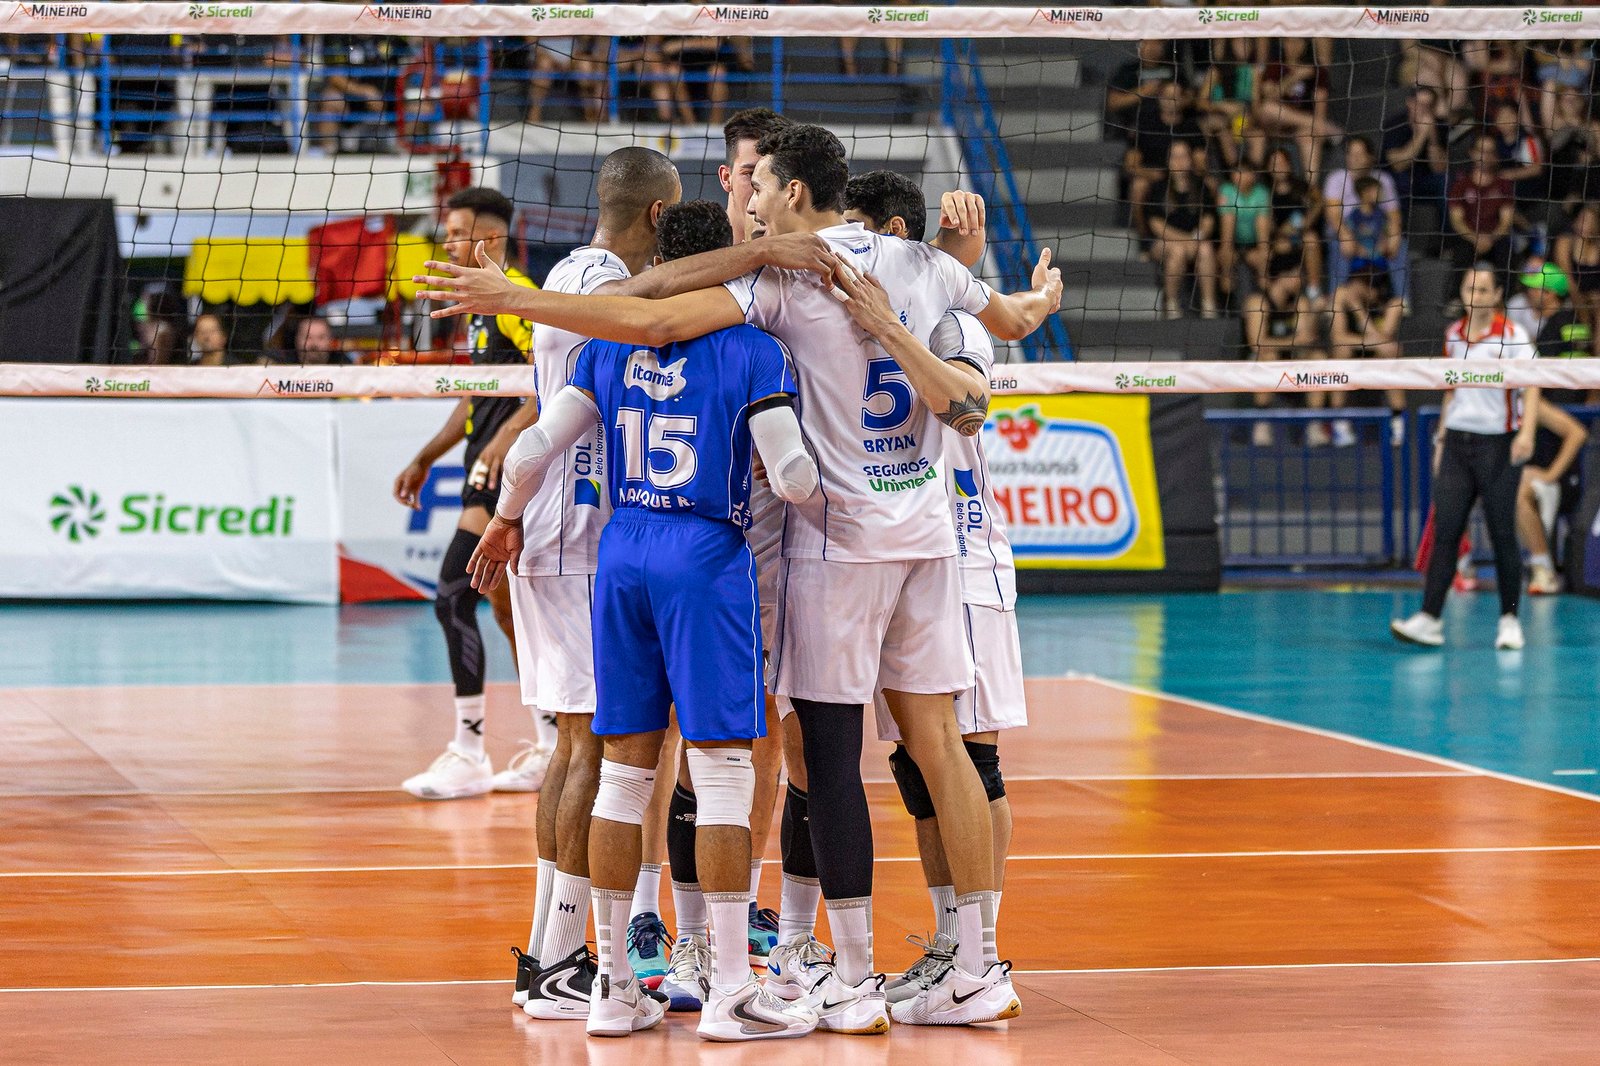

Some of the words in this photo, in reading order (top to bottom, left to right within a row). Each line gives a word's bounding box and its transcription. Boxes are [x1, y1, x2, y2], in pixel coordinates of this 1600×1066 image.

[32, 4, 87, 17] MINEIRO
[206, 5, 253, 18] Sicredi
[377, 6, 432, 19] MINEIRO
[549, 7, 594, 19] Sicredi
[715, 7, 769, 20] MINEIRO
[884, 9, 929, 22] Sicredi
[1050, 9, 1103, 22] MINEIRO
[1215, 10, 1260, 22] Sicredi
[1377, 10, 1430, 22] MINEIRO
[1539, 11, 1583, 23] Sicredi
[632, 363, 674, 387] itamé
[1132, 375, 1176, 387] Sicredi
[1296, 372, 1349, 386] MINEIRO
[1461, 371, 1504, 384] Sicredi
[103, 379, 150, 392] Sicredi
[278, 379, 334, 393] MINEIRO
[453, 378, 499, 391] Sicredi
[990, 378, 1018, 390] EIRO
[861, 356, 914, 432] 5
[614, 406, 698, 490] 15
[863, 434, 917, 453] BRYAN
[574, 442, 592, 476] CDL
[595, 456, 604, 476] Belo
[863, 457, 929, 477] SEGUROS
[868, 466, 938, 492] Unimed
[676, 495, 696, 508] R.
[993, 485, 1119, 527] NEIRO
[118, 493, 296, 536] Sicredi
[732, 501, 745, 527] DL
[956, 502, 964, 520] Belo
[967, 500, 983, 533] CDL
[956, 521, 968, 558] Horizonte
[558, 901, 577, 914] N1
[945, 906, 958, 914] N
